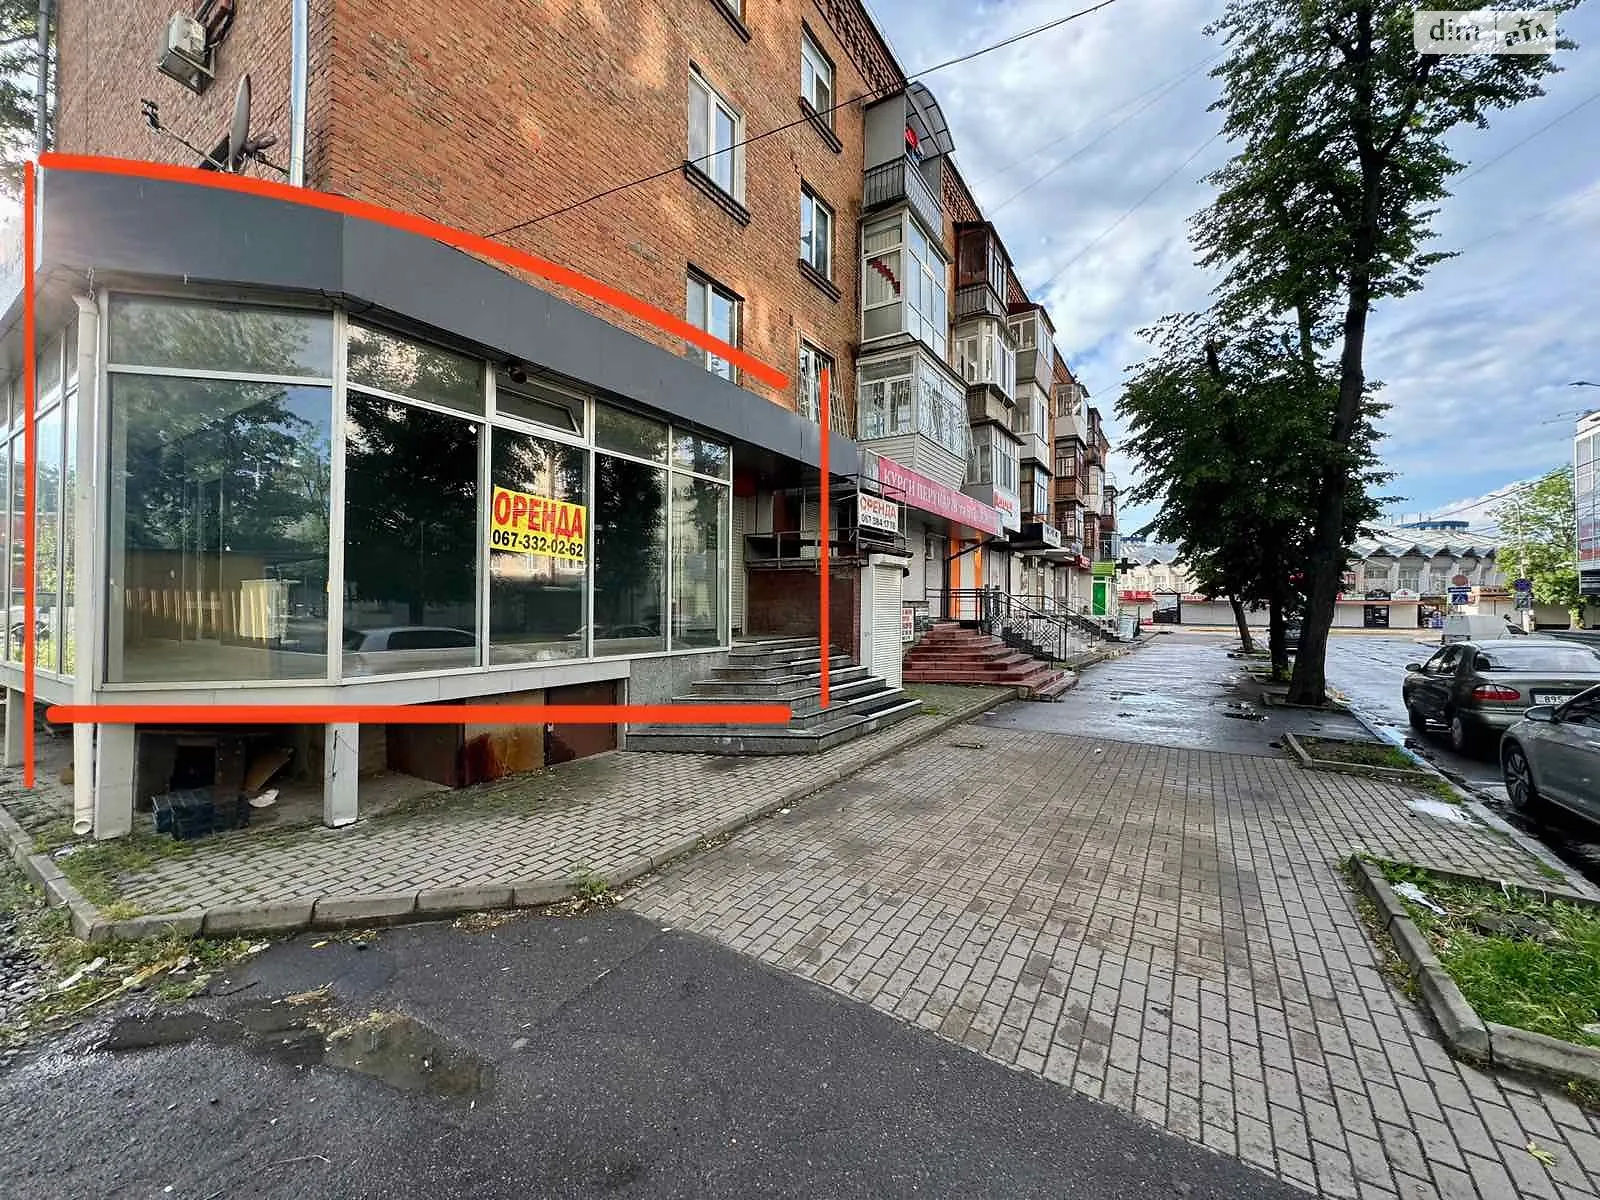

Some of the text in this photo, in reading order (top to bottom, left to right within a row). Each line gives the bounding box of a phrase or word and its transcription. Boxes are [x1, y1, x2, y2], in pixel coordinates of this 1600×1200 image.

[494, 491, 583, 542] ОРЕНДА
[861, 495, 896, 519] ОРЕНДА
[493, 529, 583, 557] 067-332-02-62
